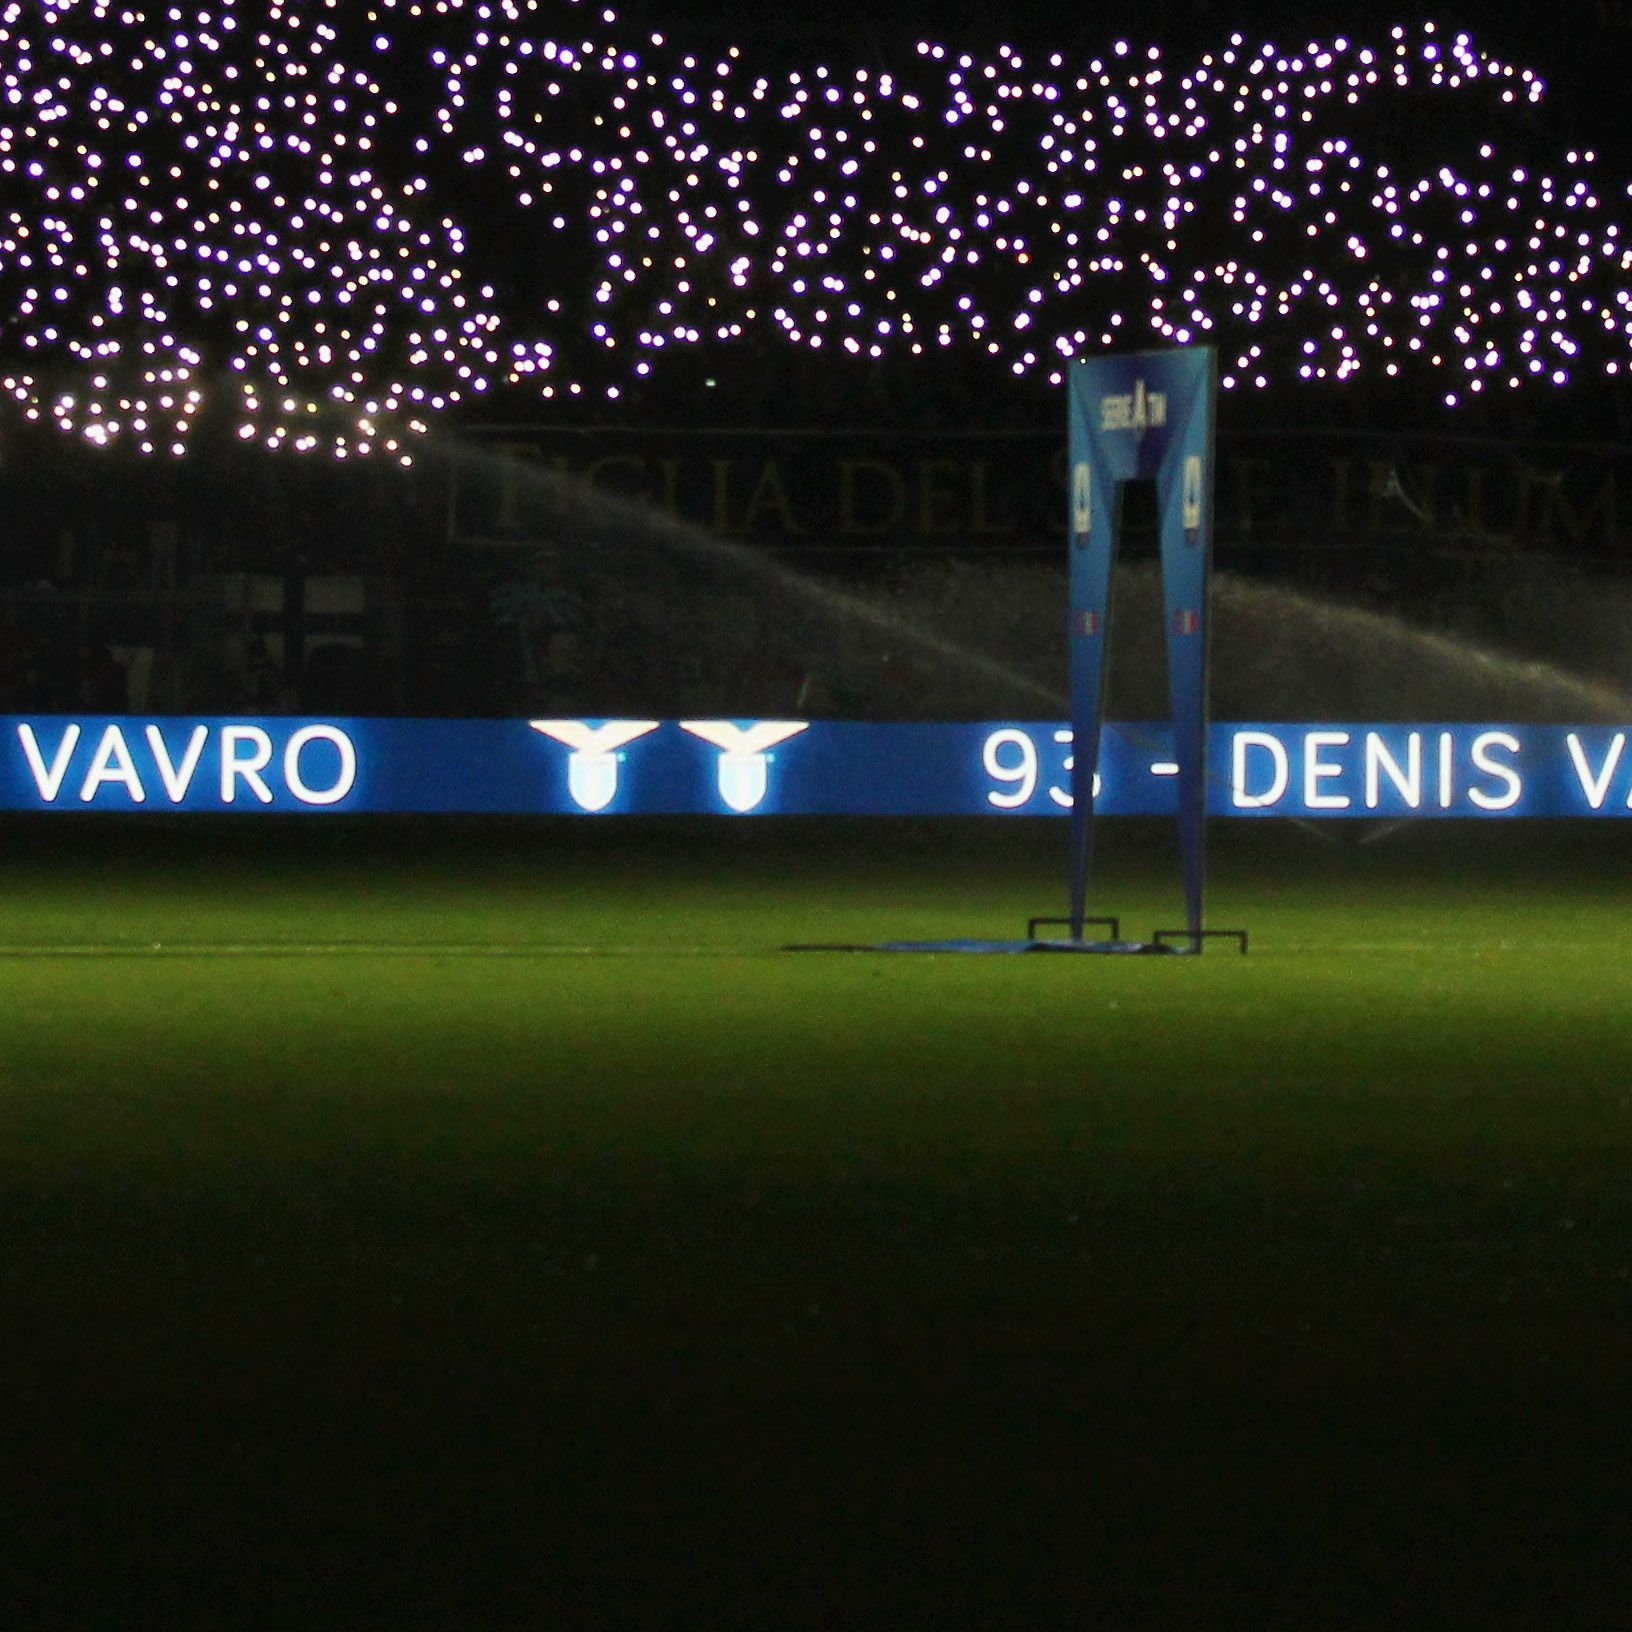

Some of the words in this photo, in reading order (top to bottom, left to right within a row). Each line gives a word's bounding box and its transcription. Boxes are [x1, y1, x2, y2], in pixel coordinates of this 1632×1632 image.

[835, 457, 1012, 535] DEL
[16, 722, 358, 806] VAVRO
[1230, 731, 1524, 811] DENIS
